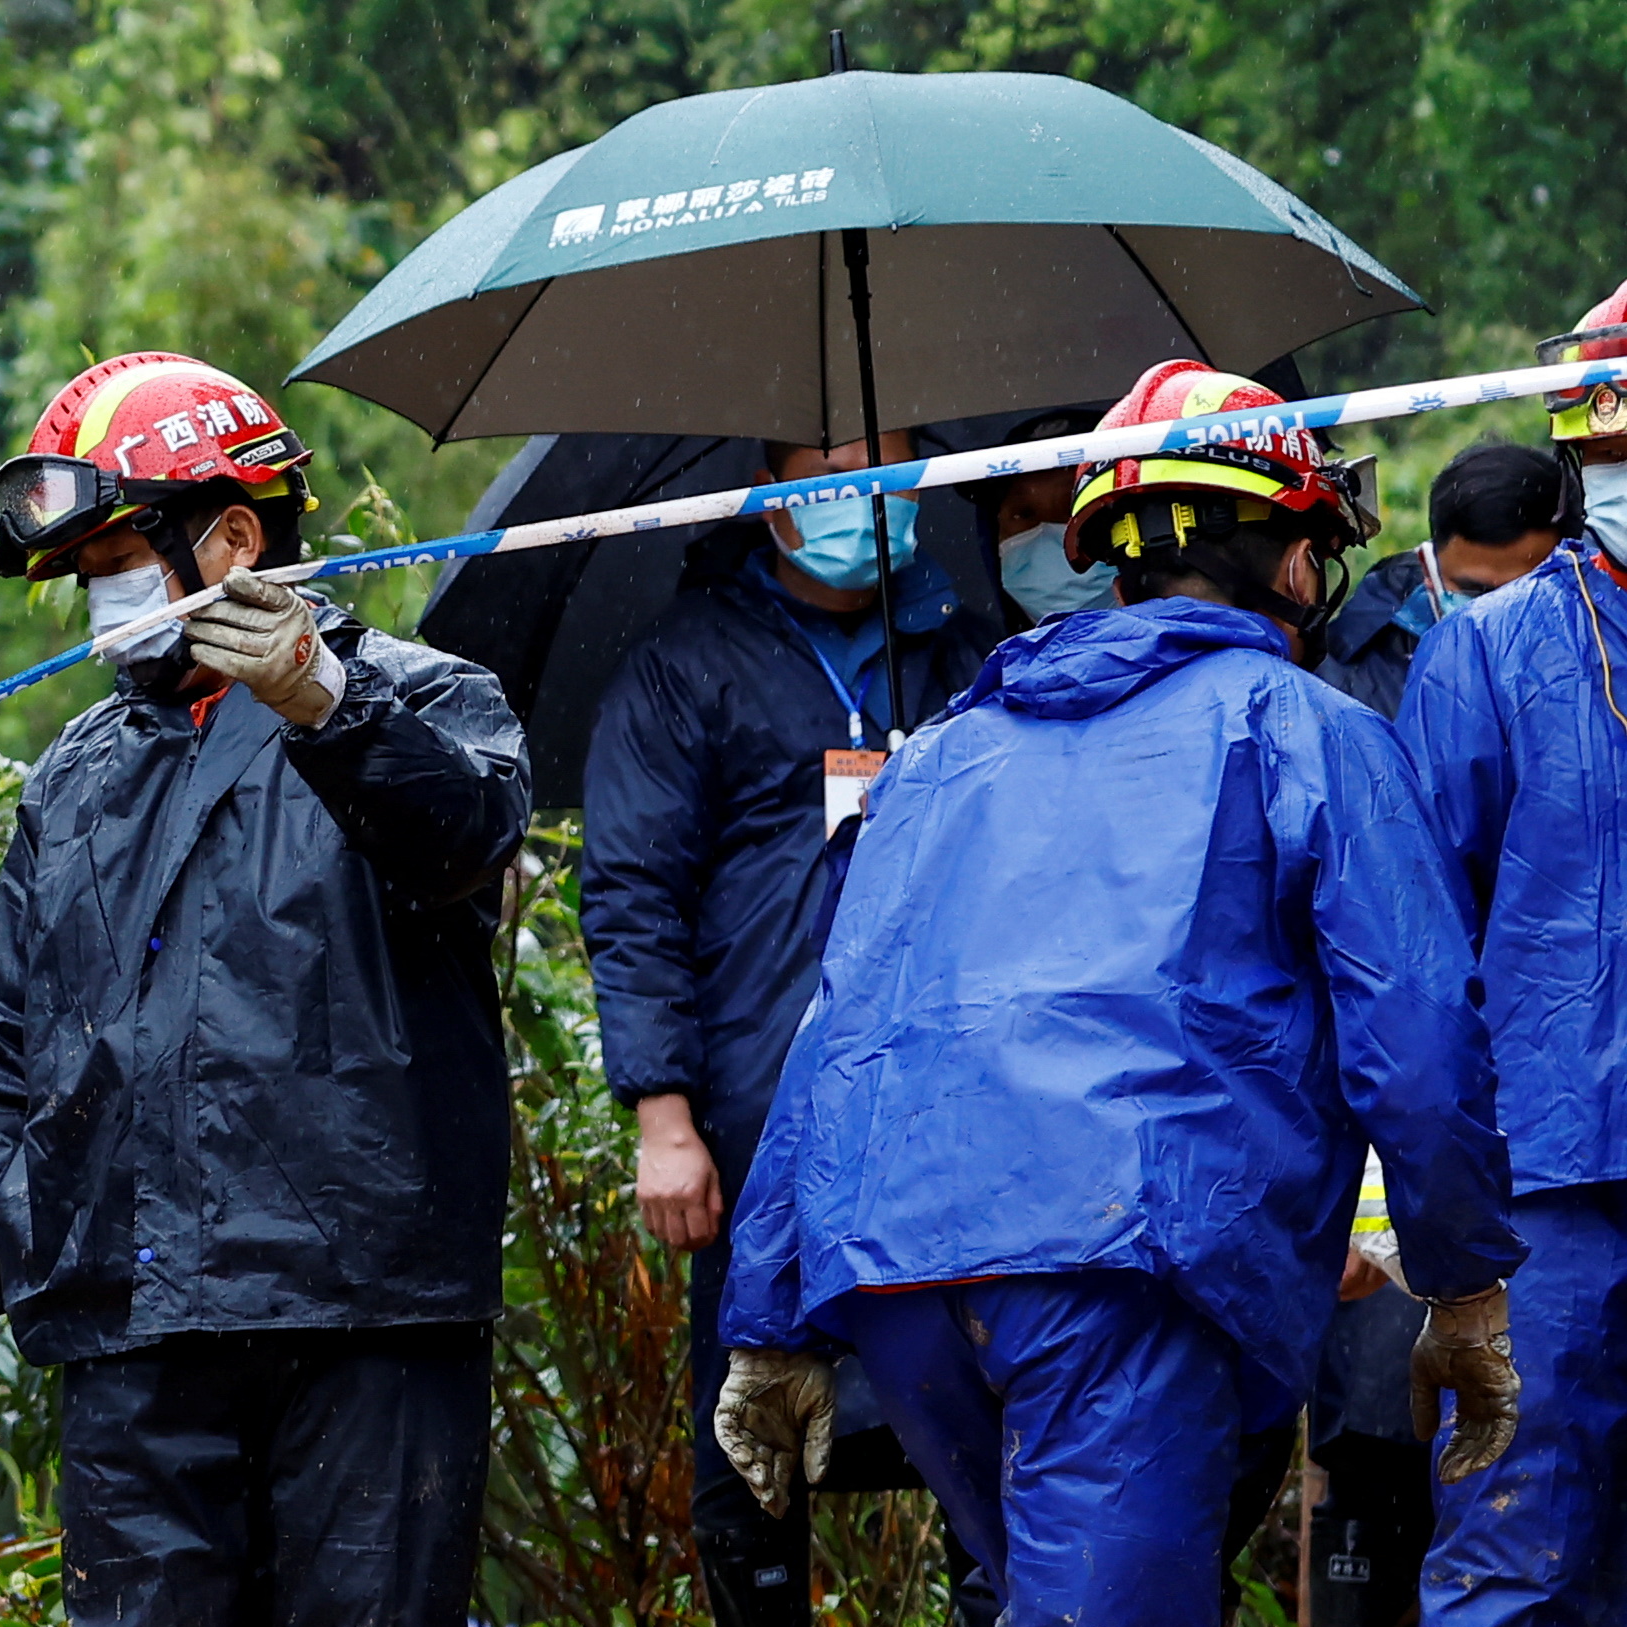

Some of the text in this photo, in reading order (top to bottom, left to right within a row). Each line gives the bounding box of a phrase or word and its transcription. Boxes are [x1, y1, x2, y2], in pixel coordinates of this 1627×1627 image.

[610, 190, 828, 238] MONALISA TILES
[616, 167, 836, 223] 蒙娜丽莎瓷砖
[113, 394, 270, 478] 广西消防
[239, 441, 283, 467] MSA
